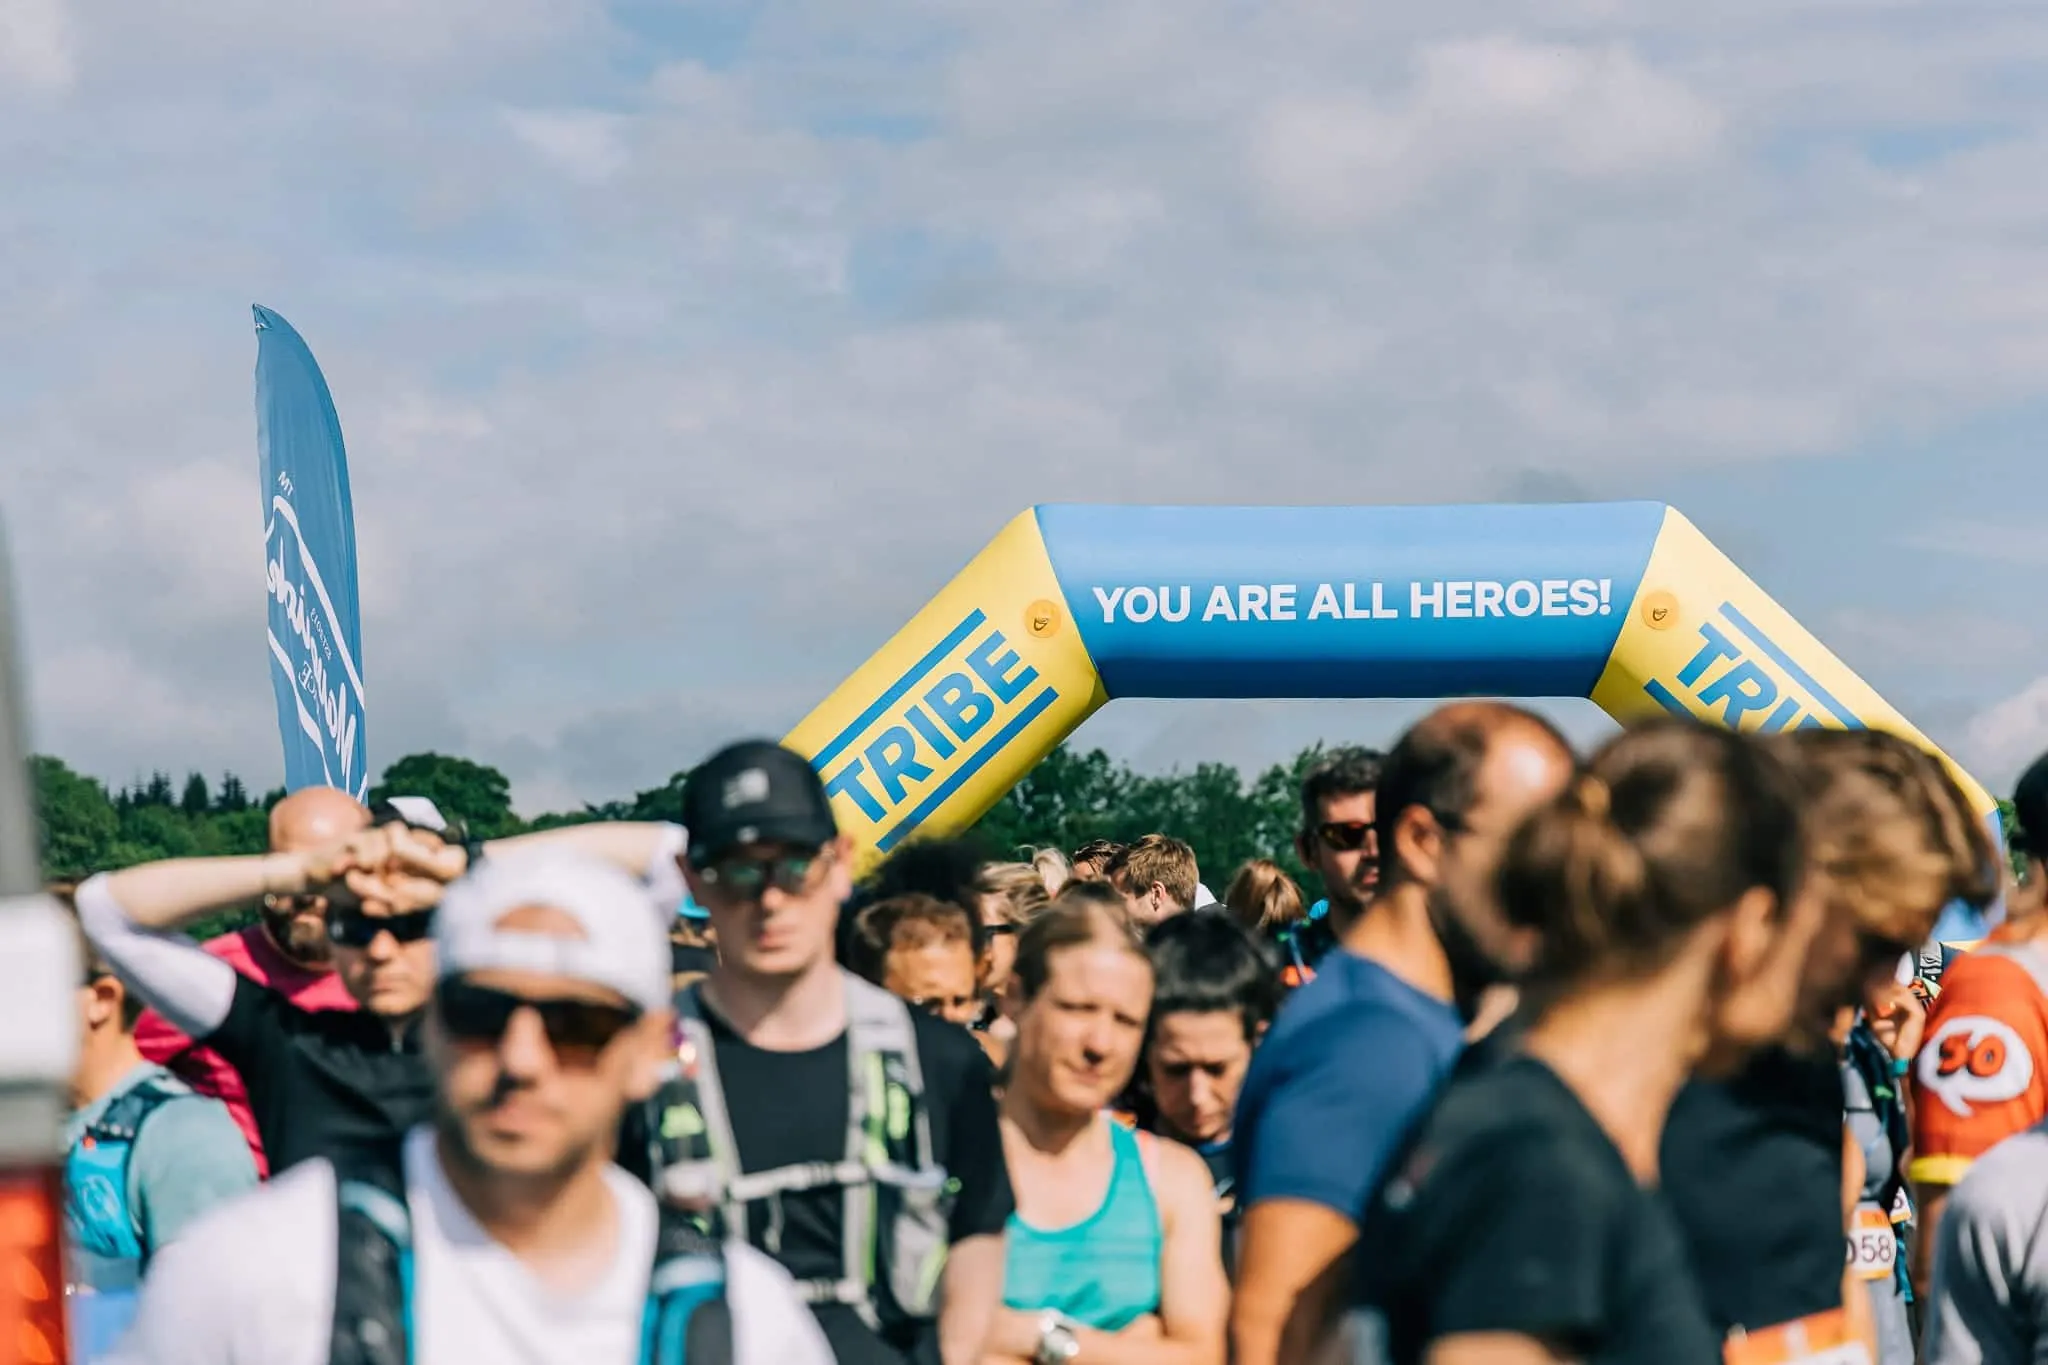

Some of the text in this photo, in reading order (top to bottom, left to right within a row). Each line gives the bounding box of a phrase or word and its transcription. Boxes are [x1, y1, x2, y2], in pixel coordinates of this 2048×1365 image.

[1093, 579, 1613, 623] YOU ARE ALL HEROES!
[825, 629, 1039, 824] TRIBE
[1676, 622, 1824, 732] TRI
